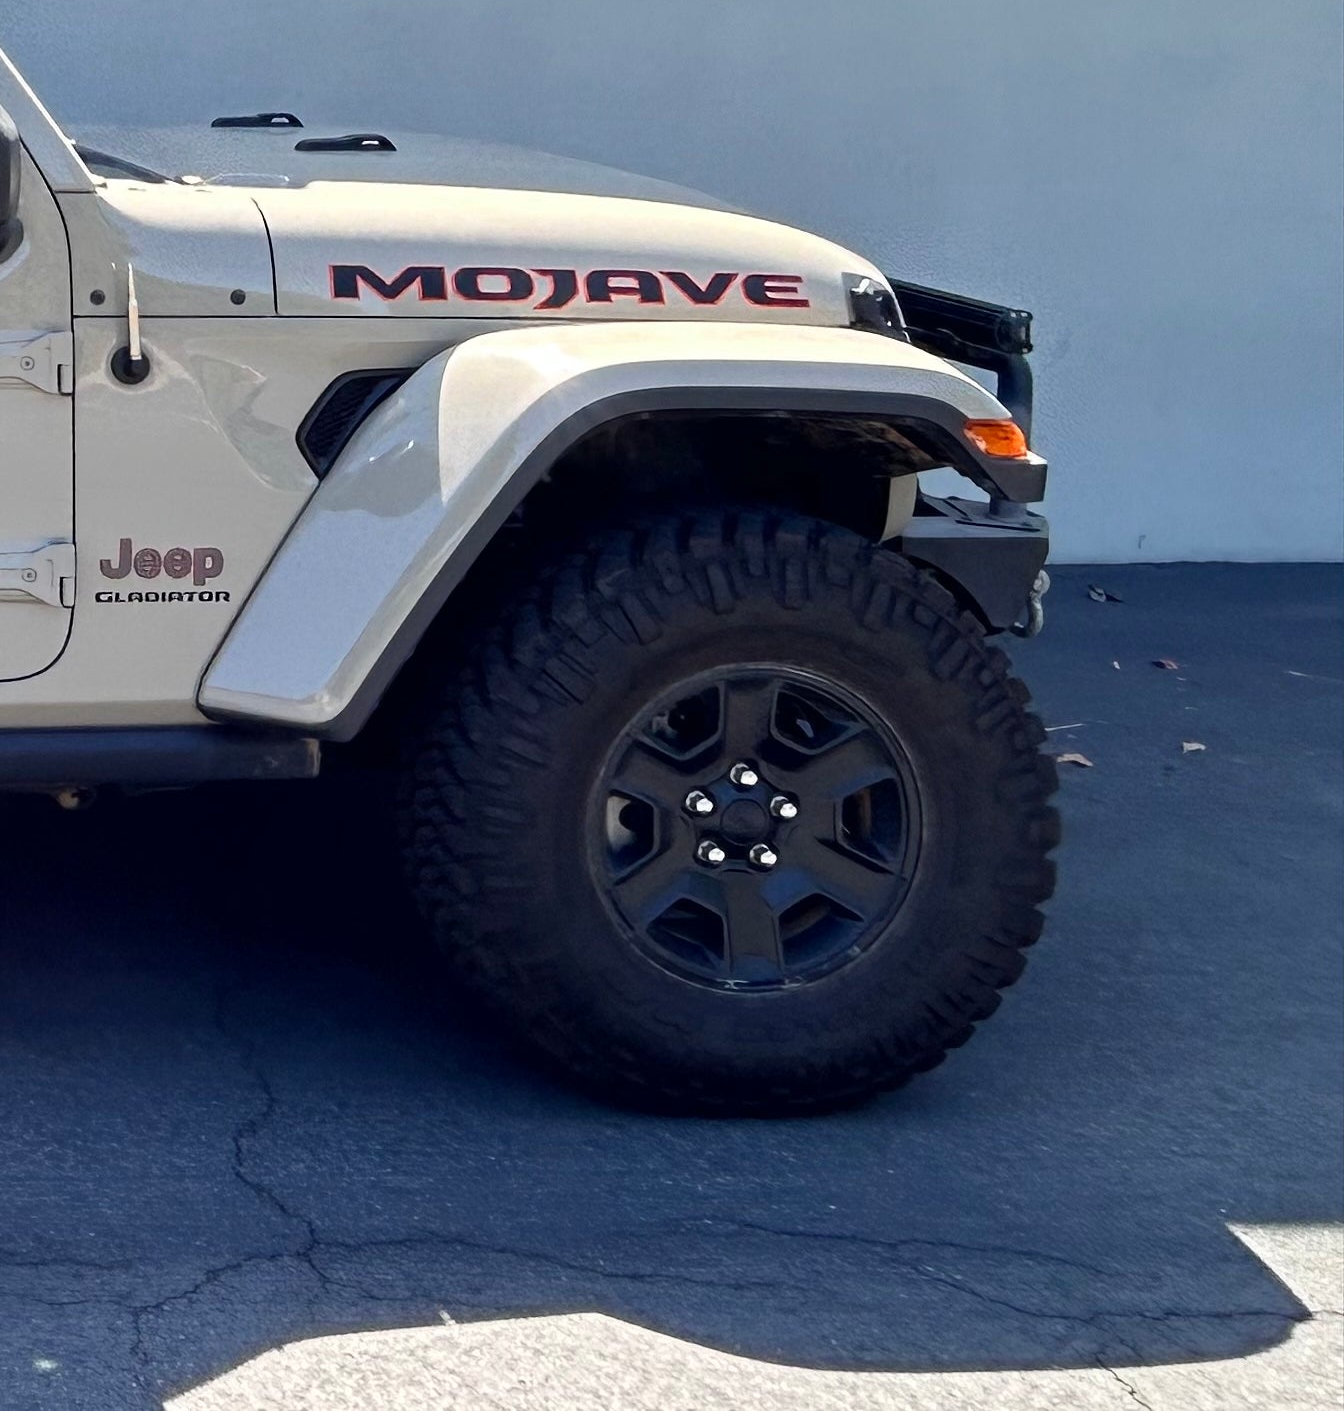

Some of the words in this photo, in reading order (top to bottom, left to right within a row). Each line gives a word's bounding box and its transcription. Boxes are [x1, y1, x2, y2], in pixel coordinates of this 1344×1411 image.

[328, 263, 811, 310] MOJAVE
[99, 538, 224, 586] Jeep
[94, 591, 230, 603] GLADIATOR
